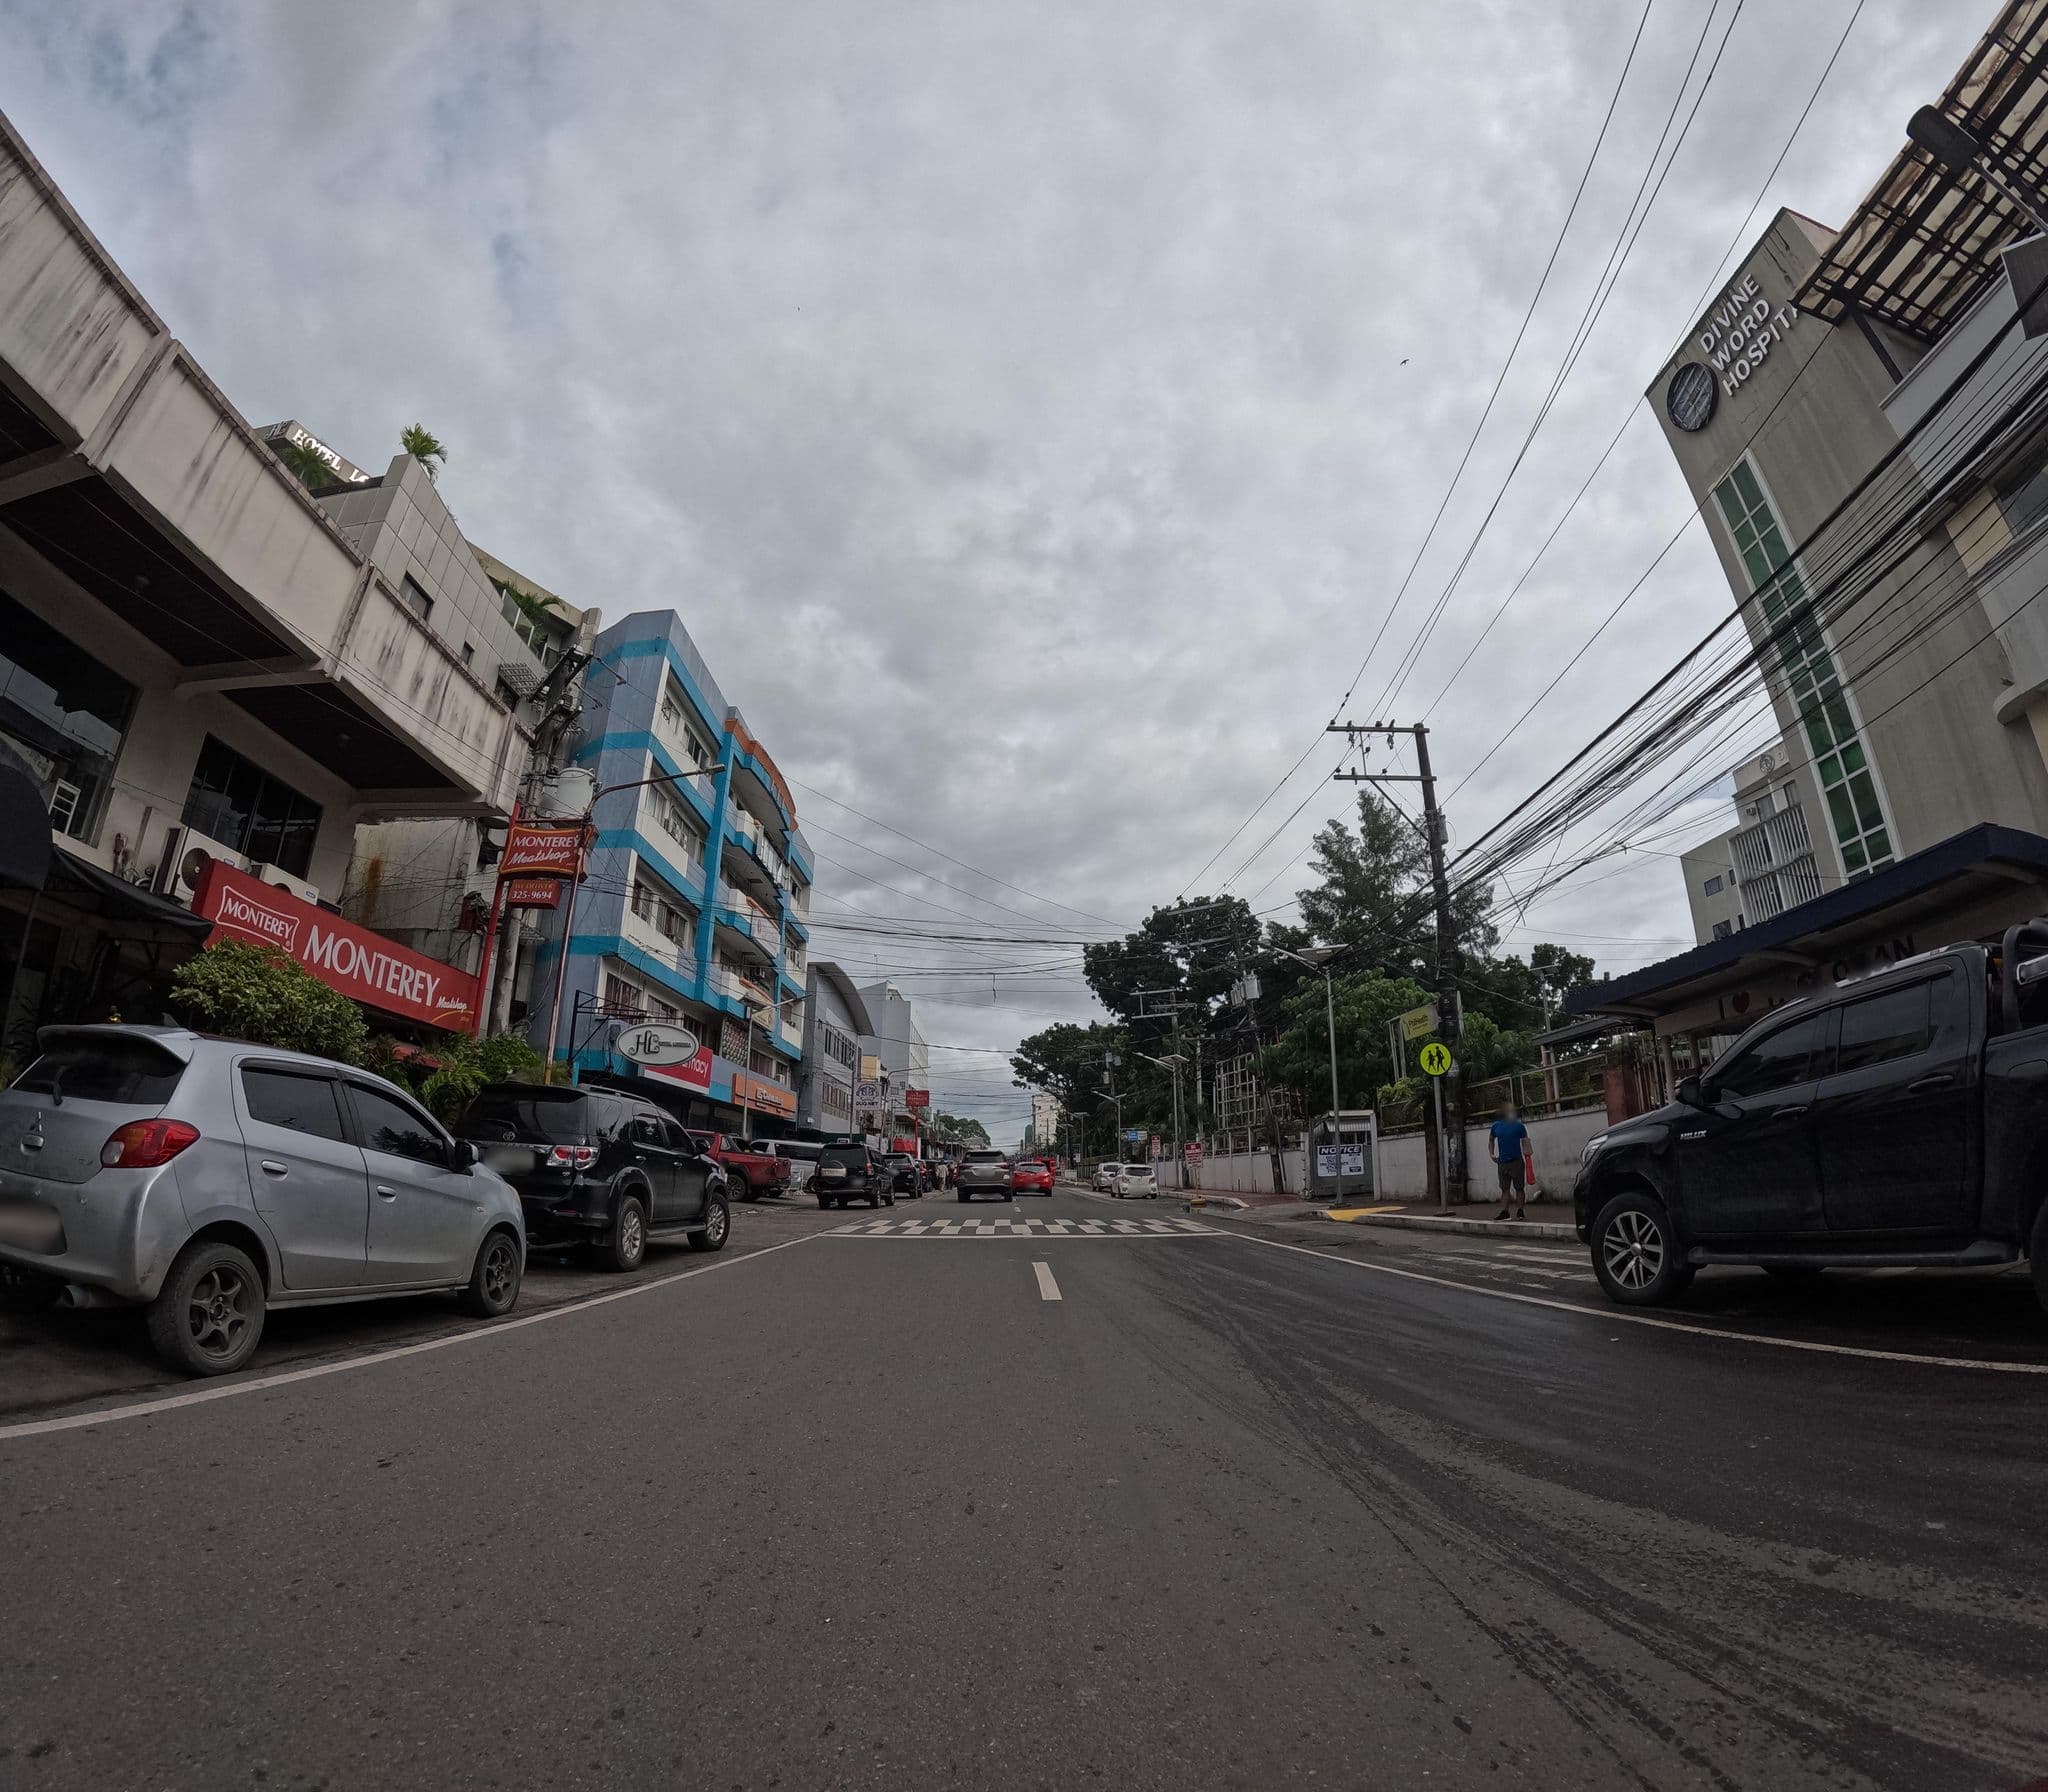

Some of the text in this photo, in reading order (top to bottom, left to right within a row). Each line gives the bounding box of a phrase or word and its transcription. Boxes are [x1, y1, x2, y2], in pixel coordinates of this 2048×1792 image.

[1700, 274, 1760, 353] DIVINE
[1712, 299, 1770, 371] WORD
[292, 429, 341, 471] HOTEL
[507, 848, 571, 865] Meatshop
[513, 835, 580, 848] MONTEREY
[512, 891, 552, 899] 325-9694
[224, 897, 294, 940] MONTEREY
[303, 925, 467, 1013] MONTEREY Meatshop
[682, 1058, 709, 1079] macy
